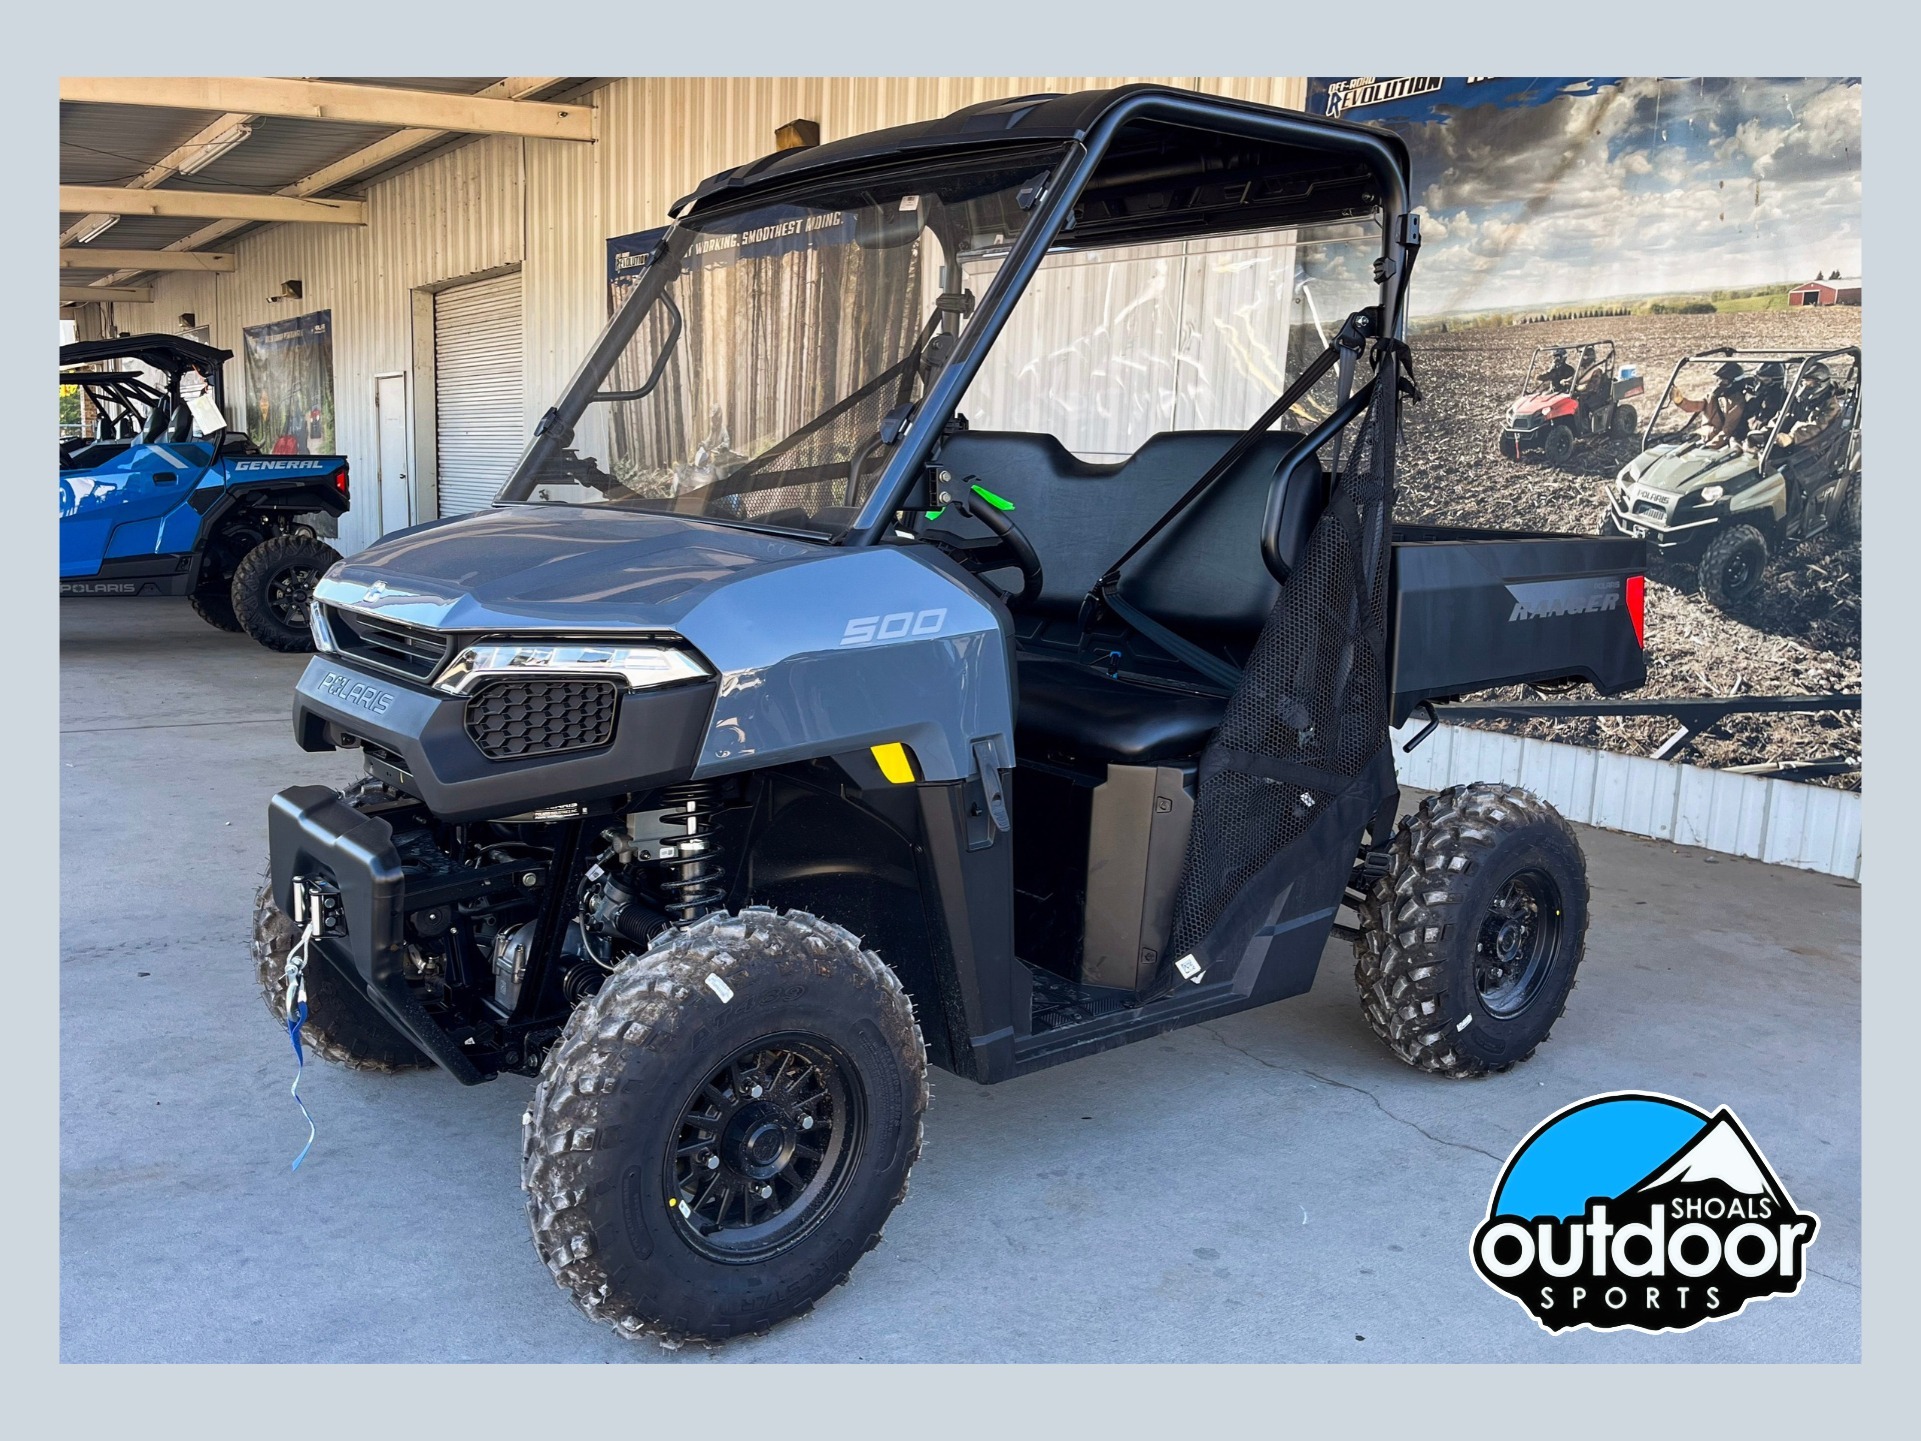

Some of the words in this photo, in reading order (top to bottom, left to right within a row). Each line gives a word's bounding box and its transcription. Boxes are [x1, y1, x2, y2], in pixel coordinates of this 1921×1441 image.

[695, 233, 740, 254] WORKING.
[742, 219, 804, 245] SMOOTHEST
[235, 460, 323, 471] GENERAL
[1637, 489, 1670, 504] POLARIS
[59, 583, 135, 593] POLARIS
[1508, 593, 1620, 622] RANGER
[840, 608, 948, 646] 500
[317, 672, 395, 714] POLARIS
